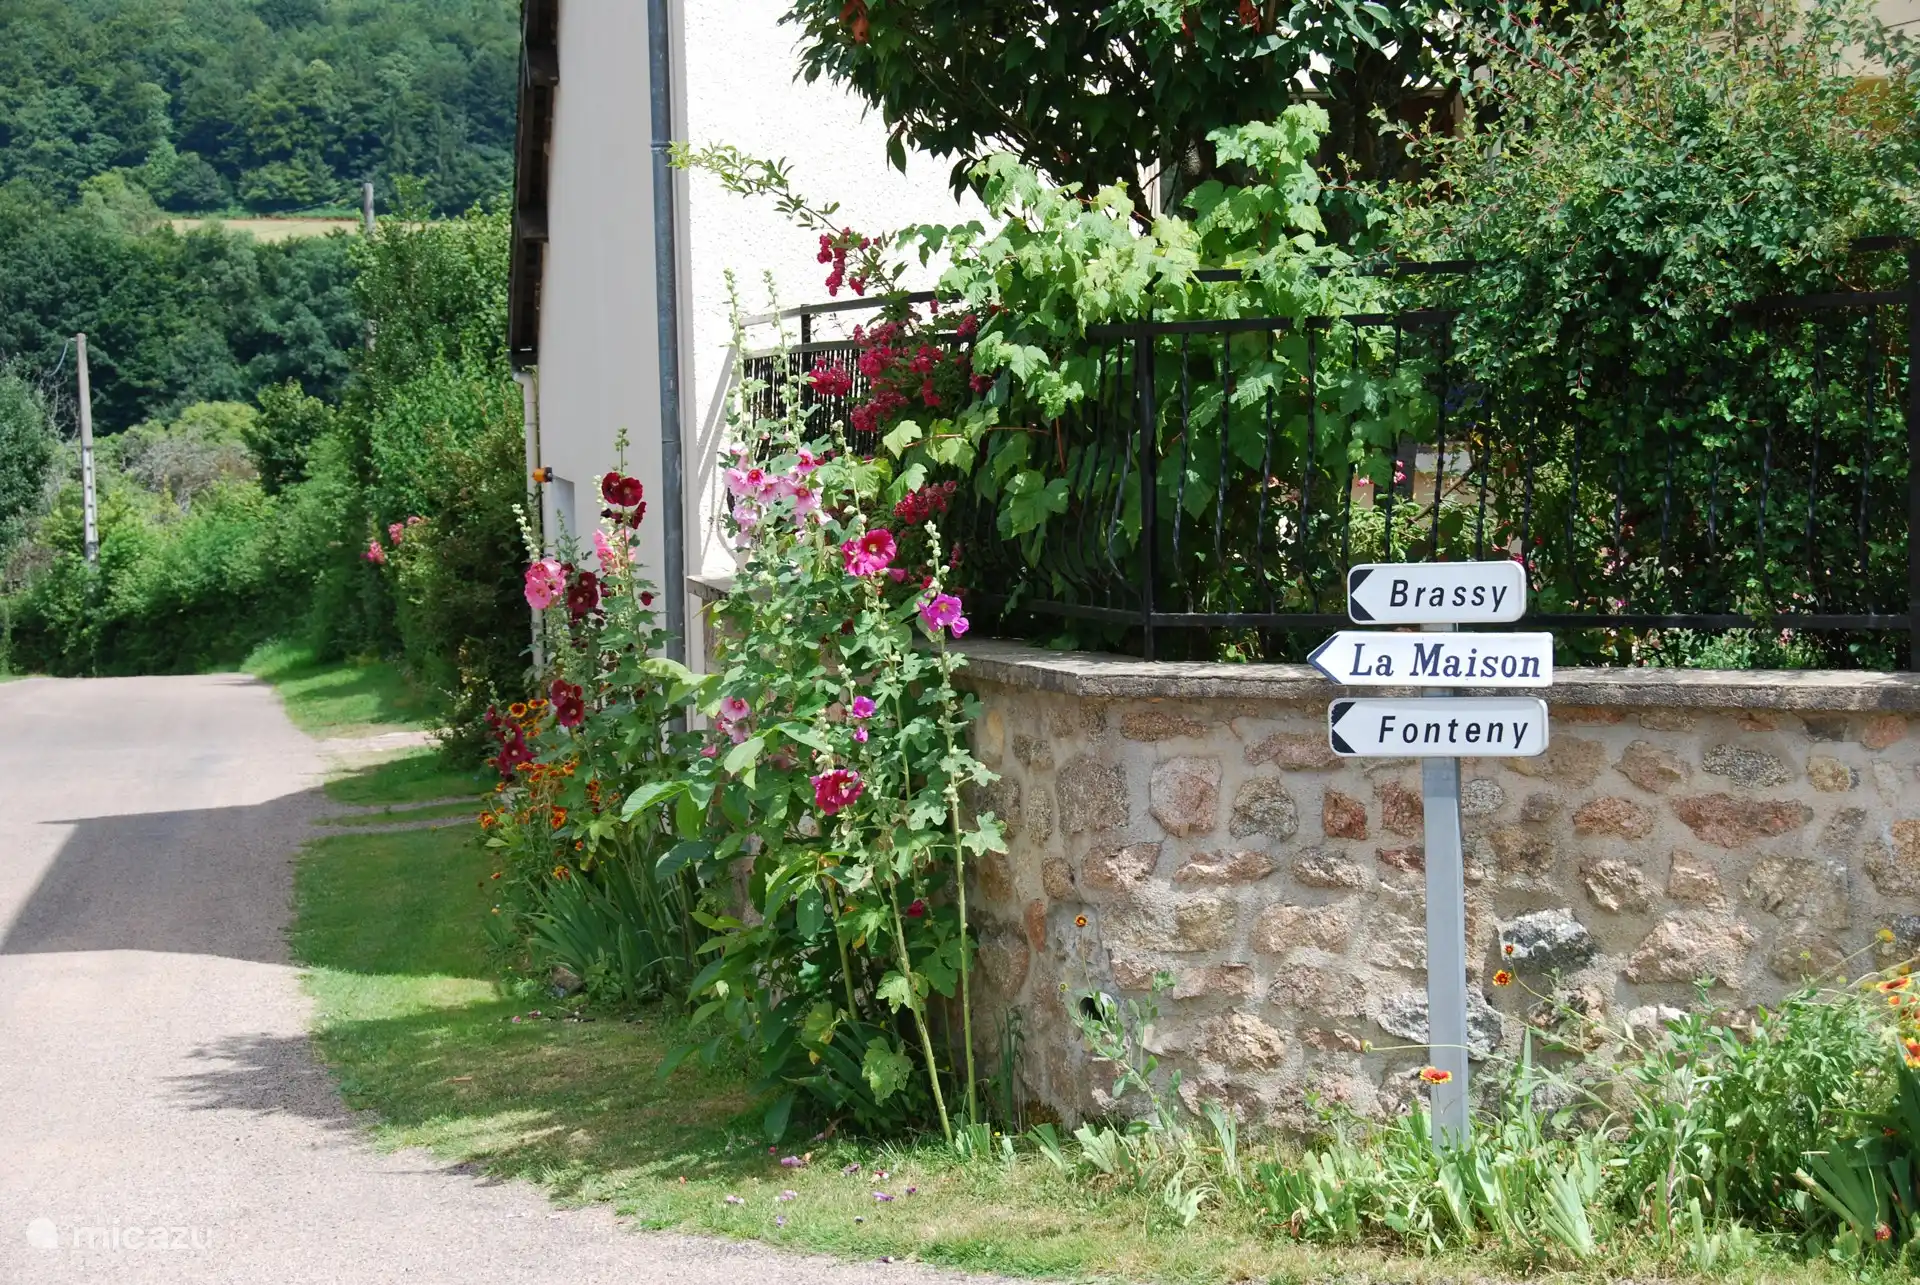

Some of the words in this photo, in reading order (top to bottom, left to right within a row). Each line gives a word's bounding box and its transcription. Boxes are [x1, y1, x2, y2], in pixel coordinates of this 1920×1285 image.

[1389, 579, 1508, 613] Brassy
[1349, 643, 1394, 677] La
[1409, 642, 1541, 678] Maison
[1378, 715, 1529, 749] Fonteny
